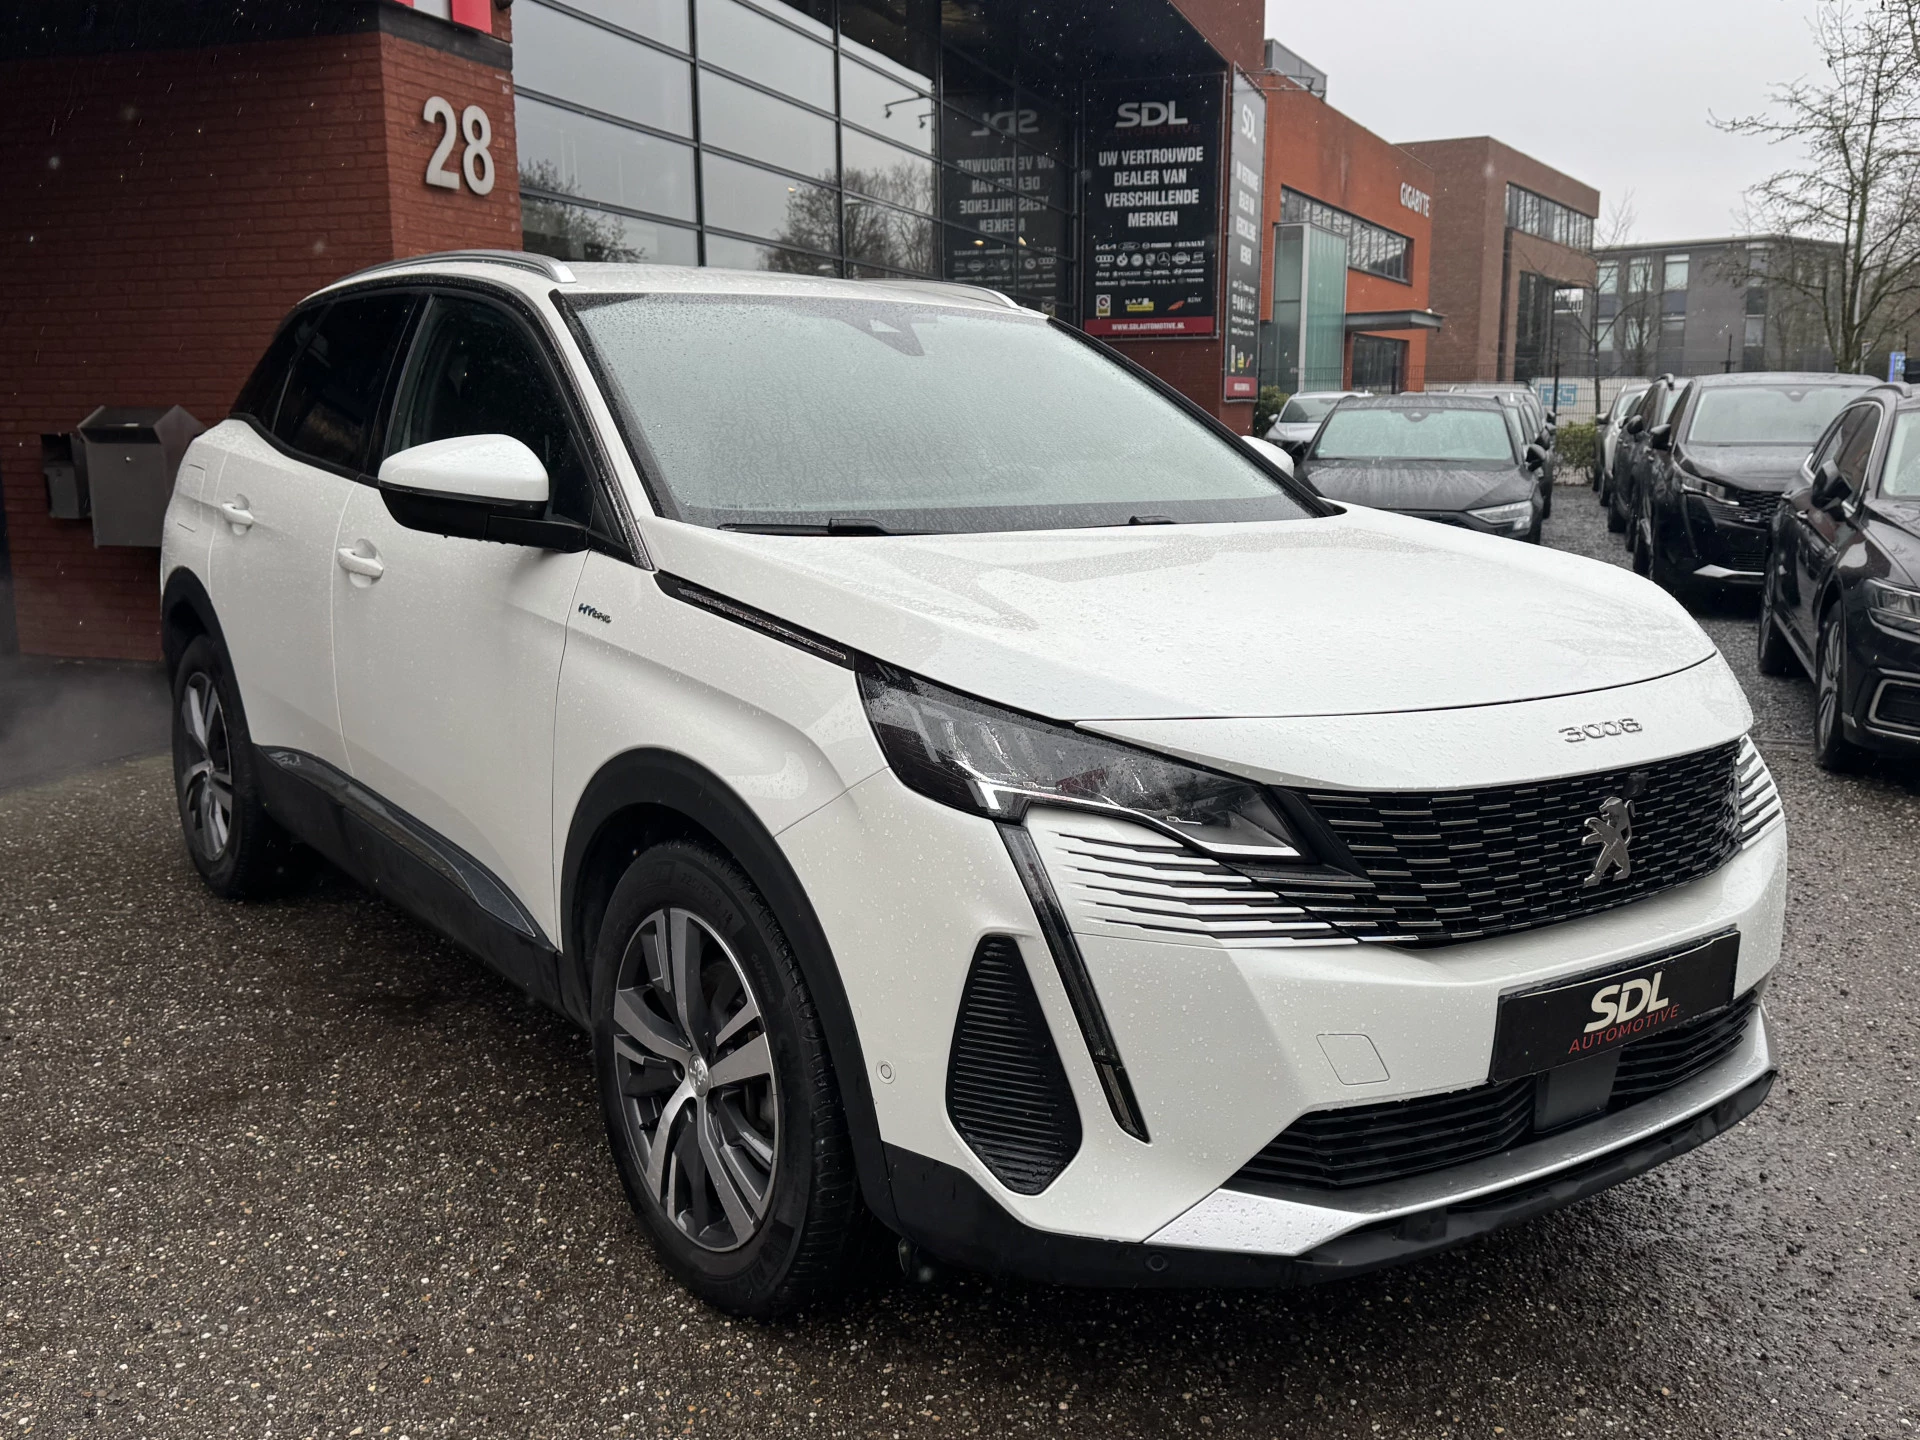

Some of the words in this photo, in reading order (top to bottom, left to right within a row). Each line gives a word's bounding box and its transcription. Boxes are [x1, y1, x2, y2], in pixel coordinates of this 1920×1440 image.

[1115, 100, 1188, 128] SDL
[423, 96, 495, 196] 28
[1099, 151, 1118, 167] UW
[1121, 146, 1204, 166] VERTROUWDE
[1114, 170, 1160, 187] DEALER
[1163, 168, 1187, 185] VAN
[1105, 188, 1200, 208] VERSCHILLENDE
[1128, 211, 1179, 228] MERKEN
[1558, 718, 1642, 743] 3008
[1583, 971, 1669, 1033] SDL
[1568, 1004, 1680, 1054] AUTOMOTIVE
